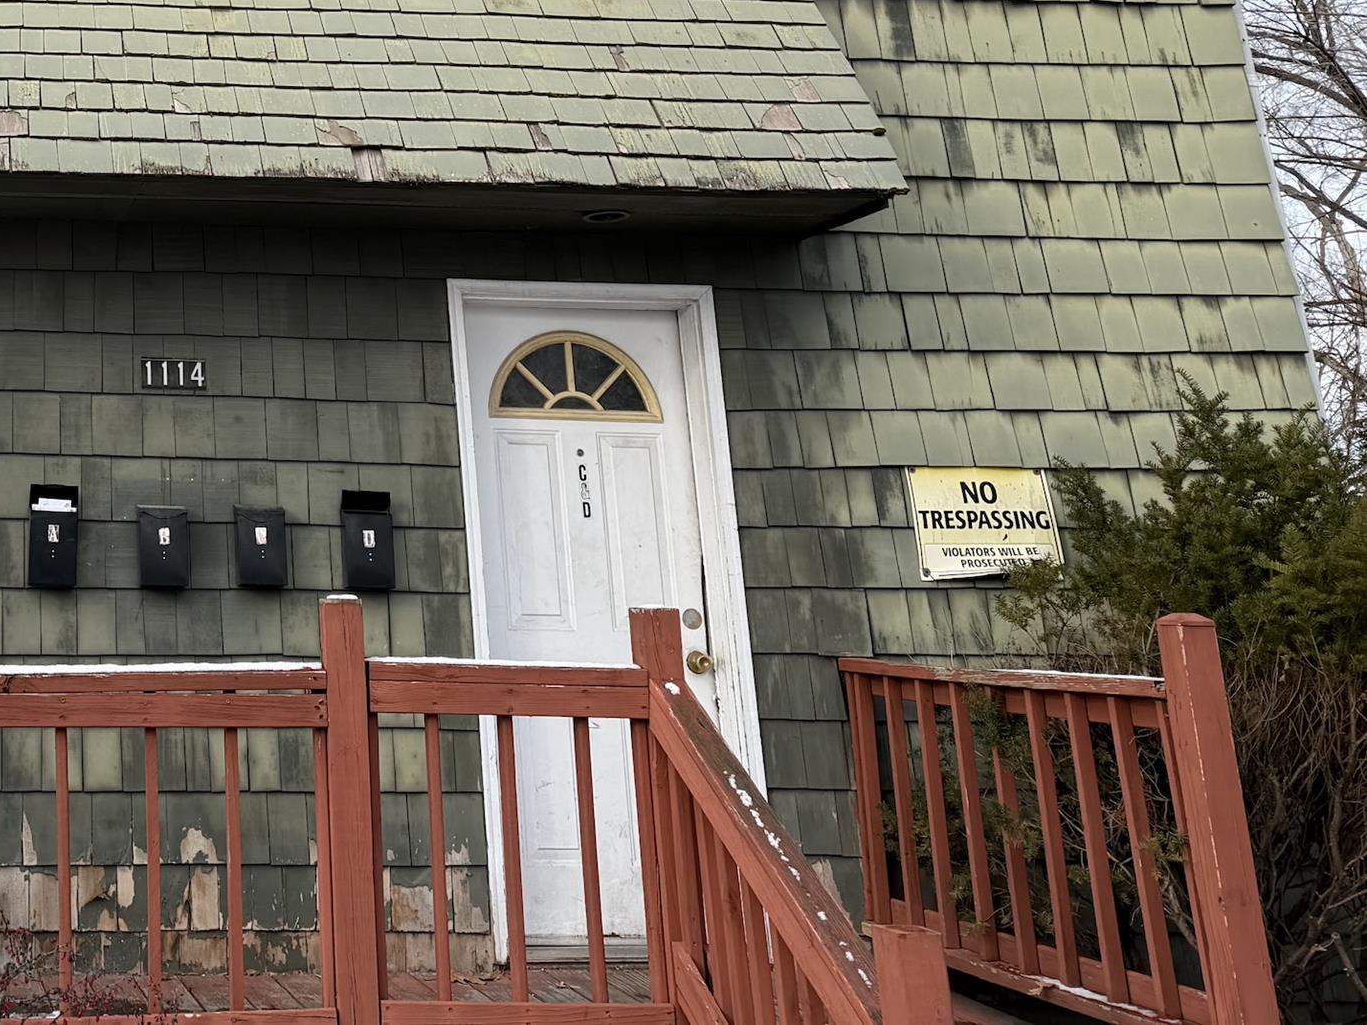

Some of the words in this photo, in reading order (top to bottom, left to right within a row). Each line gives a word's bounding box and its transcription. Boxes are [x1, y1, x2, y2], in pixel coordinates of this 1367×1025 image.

[145, 359, 205, 387] 1114
[959, 481, 998, 505] NO
[917, 509, 1051, 530] TRESPASSING
[48, 523, 60, 543] A
[941, 547, 996, 557] VIOLATORS
[997, 547, 1024, 556] WILL
[1025, 546, 1040, 556] BE
